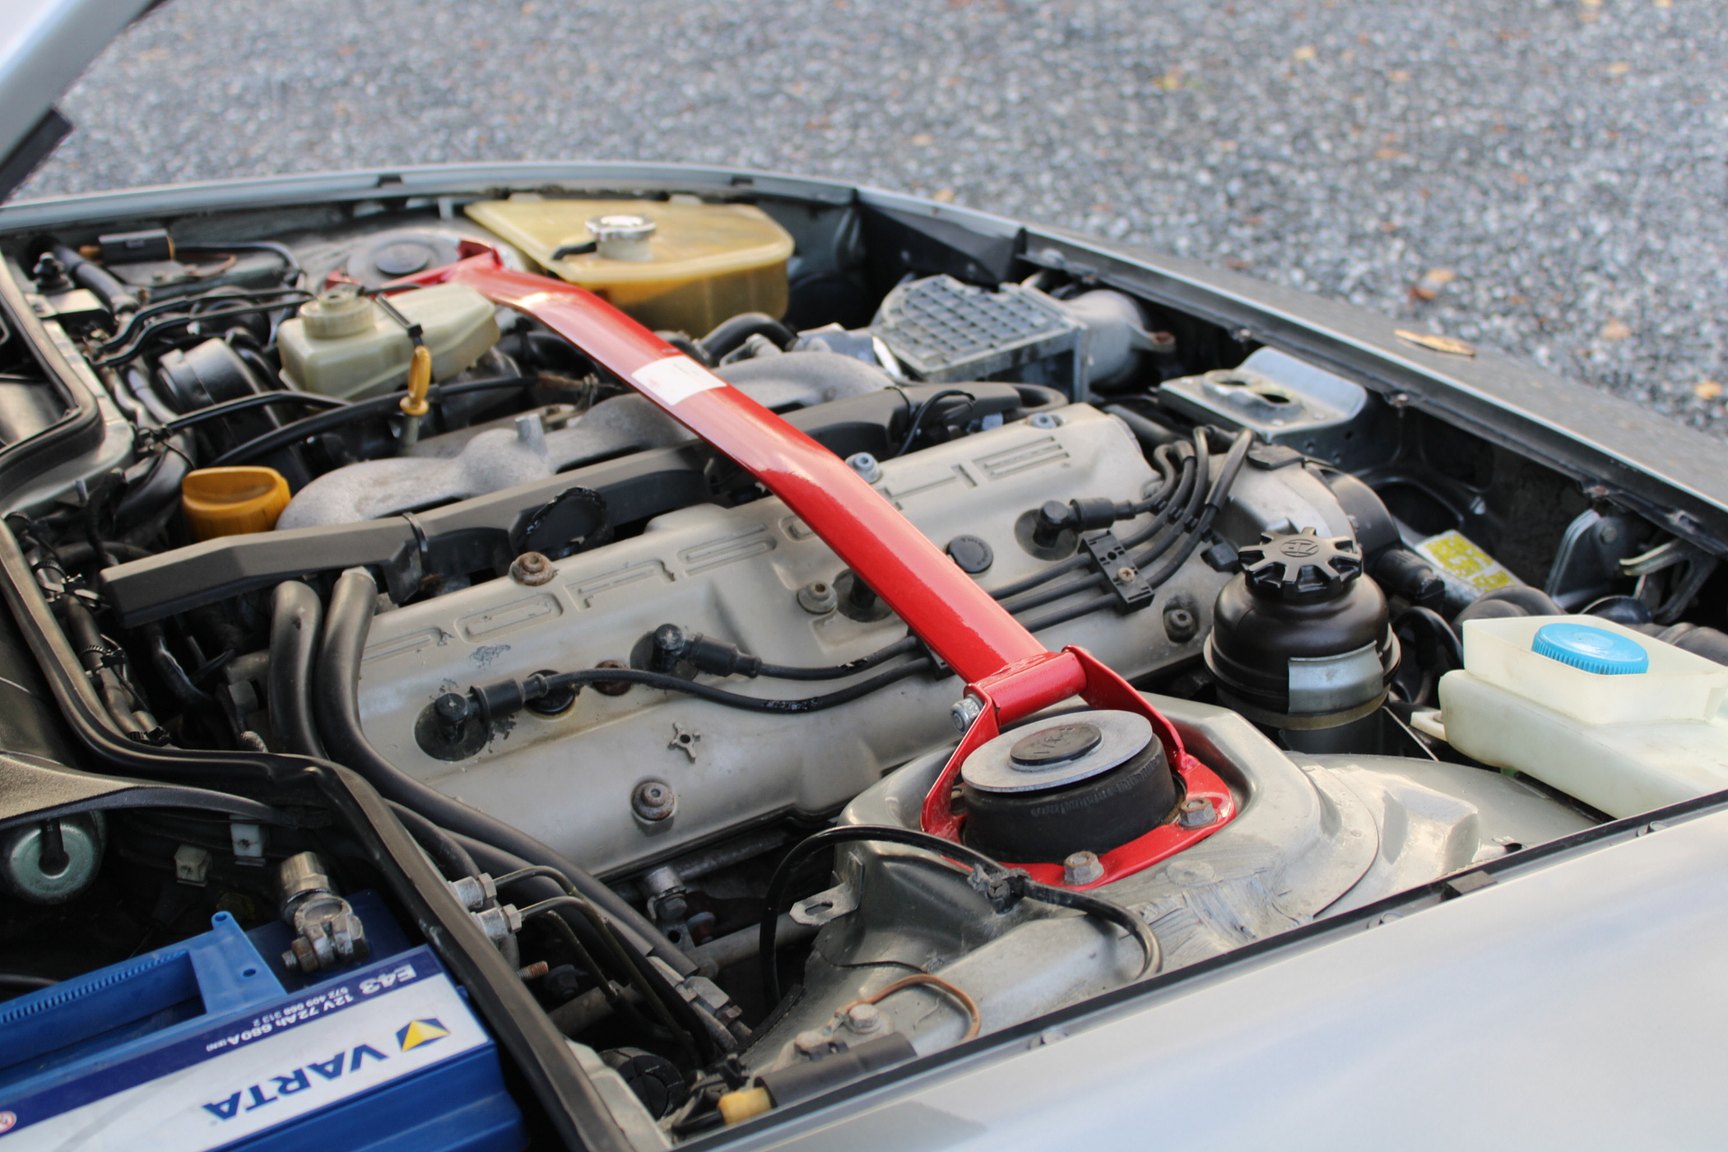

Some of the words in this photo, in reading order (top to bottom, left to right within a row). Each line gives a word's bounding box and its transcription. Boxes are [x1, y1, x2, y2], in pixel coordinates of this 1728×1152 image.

[359, 963, 417, 995] E43
[323, 994, 354, 1011] 12V
[275, 1007, 320, 1027] 72Ah
[202, 1043, 390, 1121] VARTA
